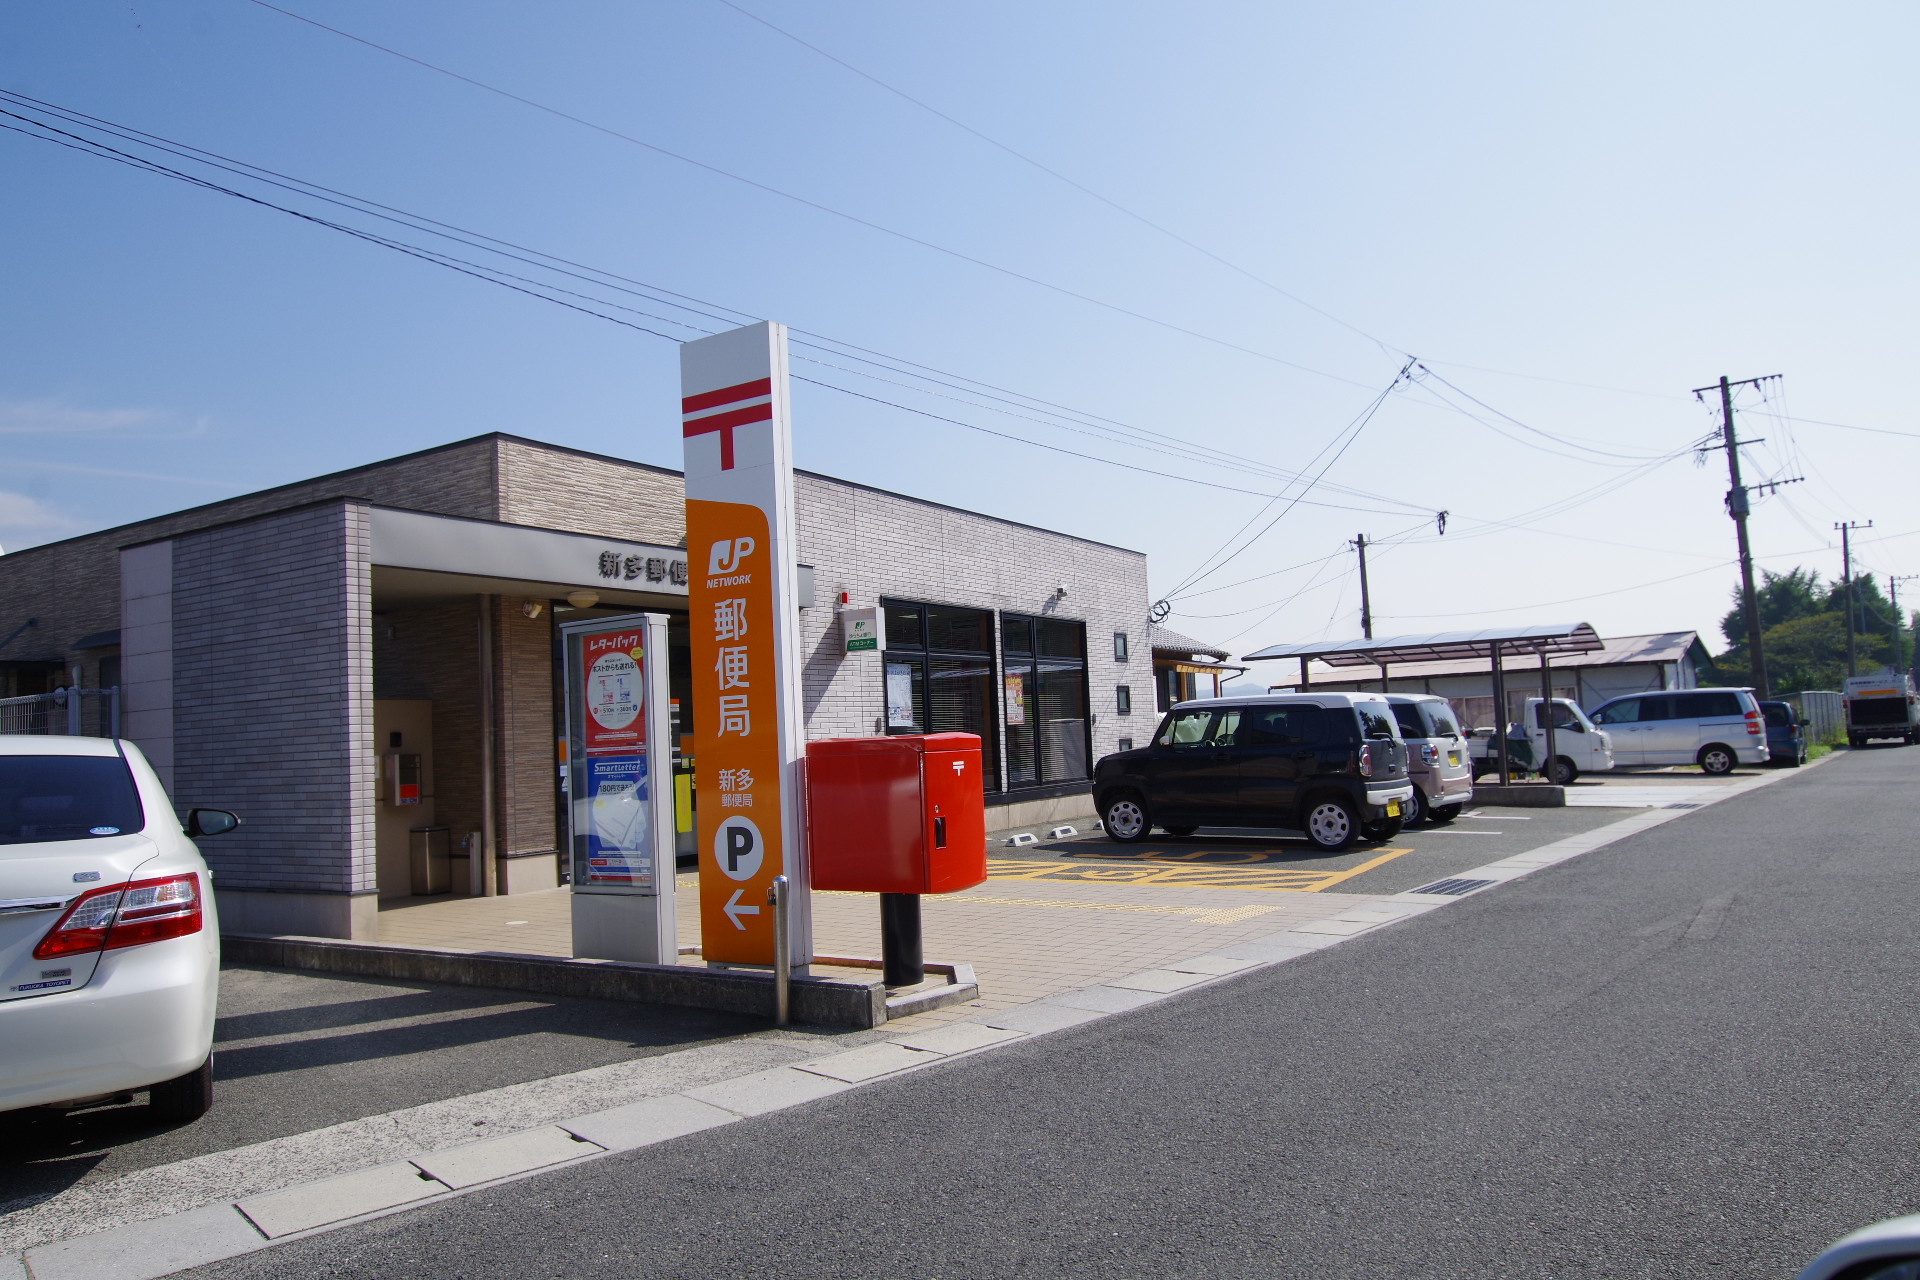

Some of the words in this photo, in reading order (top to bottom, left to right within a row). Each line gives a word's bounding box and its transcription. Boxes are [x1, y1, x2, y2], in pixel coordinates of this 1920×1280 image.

[599, 550, 688, 584] 新多郵便
[706, 574, 752, 589] NETWORK
[590, 635, 639, 651] レターパック
[714, 598, 751, 738] 郵便局
[719, 768, 754, 791] 新多
[721, 794, 753, 807] 郵便局
[727, 826, 754, 871] P
